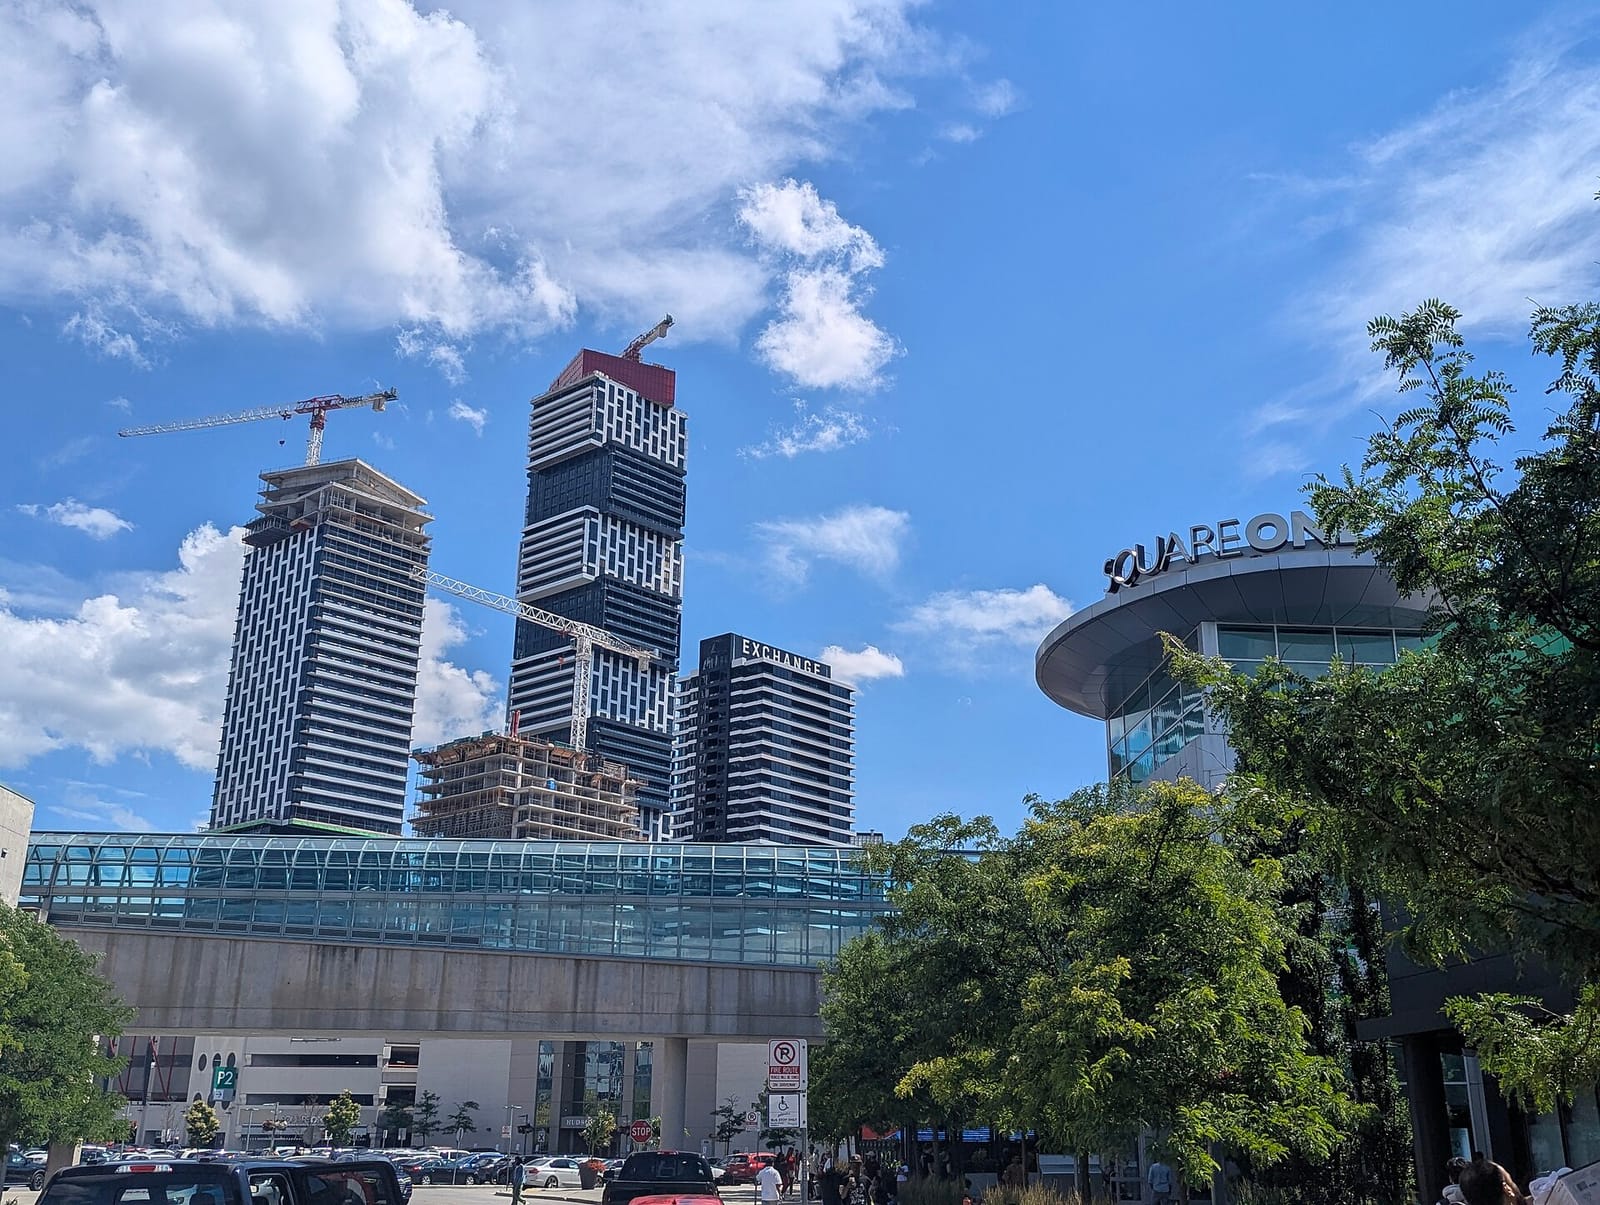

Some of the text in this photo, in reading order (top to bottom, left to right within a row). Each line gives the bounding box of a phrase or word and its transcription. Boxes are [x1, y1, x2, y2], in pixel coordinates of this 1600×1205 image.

[742, 638, 821, 675] EXCHANGE
[783, 1066, 798, 1074] ROUTE
[217, 1071, 233, 1085] P2
[632, 1127, 651, 1136] STOP
